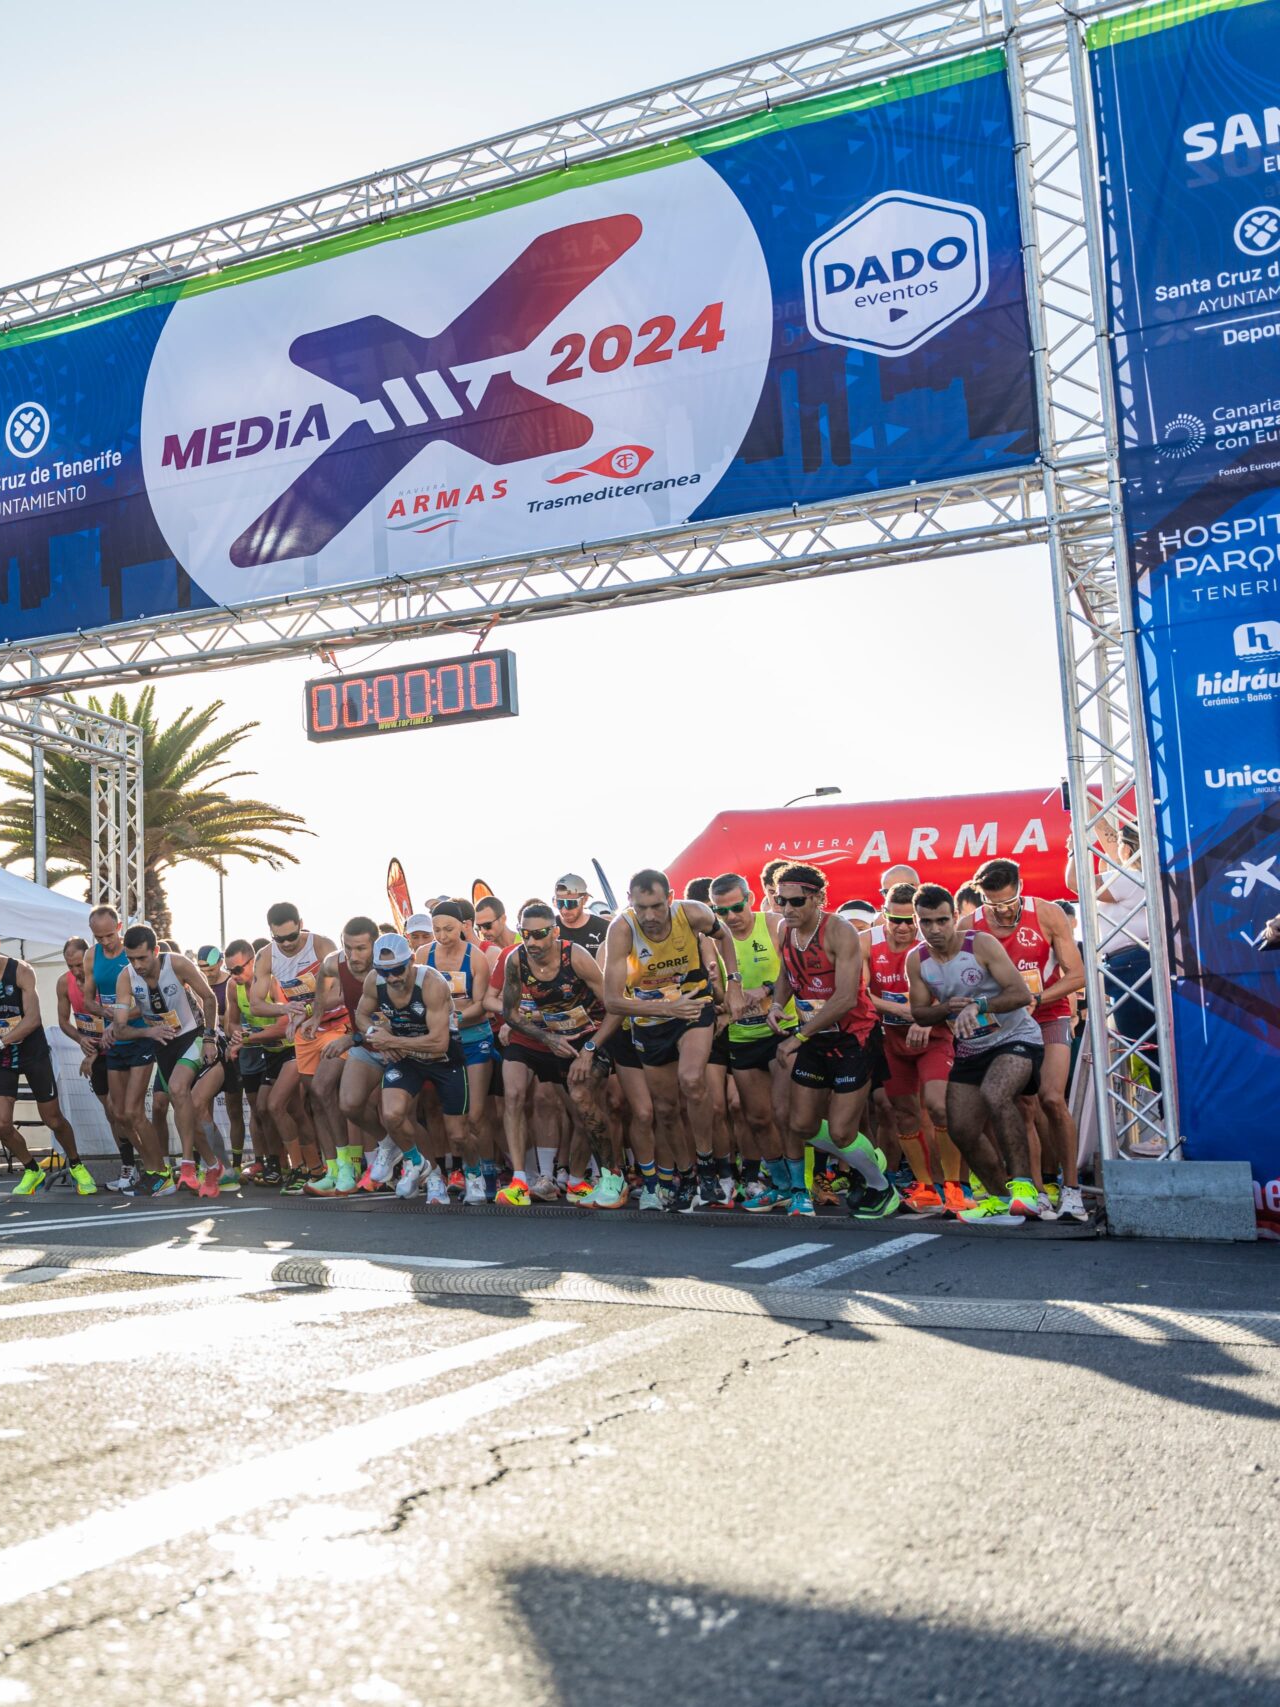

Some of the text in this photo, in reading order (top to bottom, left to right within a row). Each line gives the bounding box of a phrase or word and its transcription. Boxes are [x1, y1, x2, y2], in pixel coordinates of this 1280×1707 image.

[824, 236, 967, 295] DADO
[854, 279, 938, 309] eventos
[1155, 279, 1211, 302] Santa
[1217, 268, 1262, 288] Cruz
[546, 301, 725, 386] 2024
[1215, 435, 1249, 451] con
[31, 467, 50, 485] de
[53, 452, 122, 480] Tenerife
[1218, 466, 1248, 477] Fondo
[387, 479, 508, 520] ARMAS
[399, 483, 446, 496] NAVIERA
[527, 473, 701, 514] Trasmediterranea
[1192, 578, 1277, 602] TENERI
[312, 659, 498, 732] 00:00:00
[1203, 692, 1272, 707] Cerámica Baños
[765, 818, 1048, 864] NAVIERA ARMA
[648, 955, 689, 971] CORRE
[1018, 959, 1038, 970] Cruz
